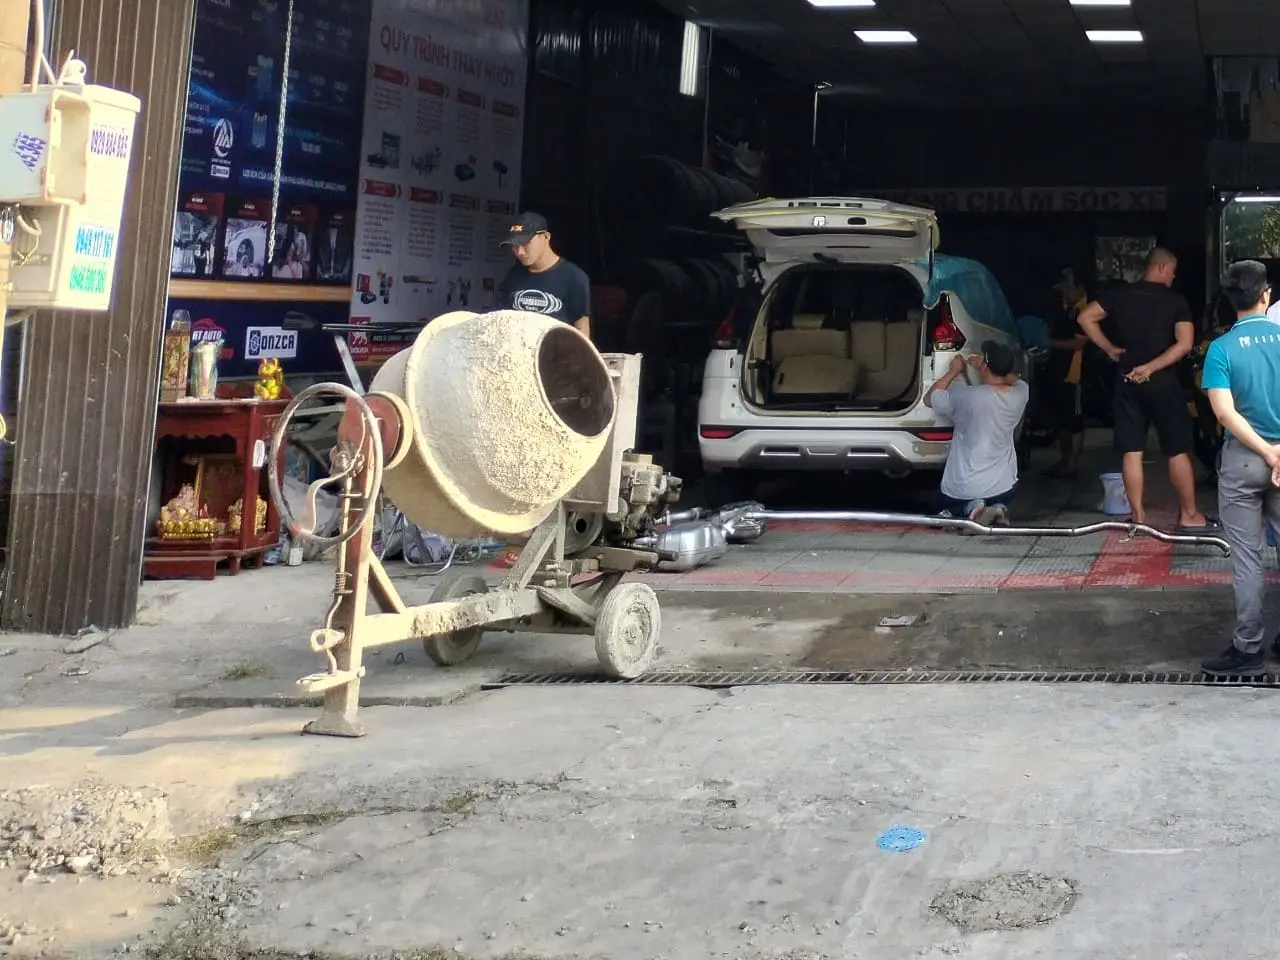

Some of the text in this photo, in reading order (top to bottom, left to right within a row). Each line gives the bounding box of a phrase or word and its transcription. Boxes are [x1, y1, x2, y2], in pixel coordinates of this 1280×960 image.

[380, 25, 410, 55] QUY
[413, 34, 450, 69] TRÌNH
[452, 49, 483, 80] THAY
